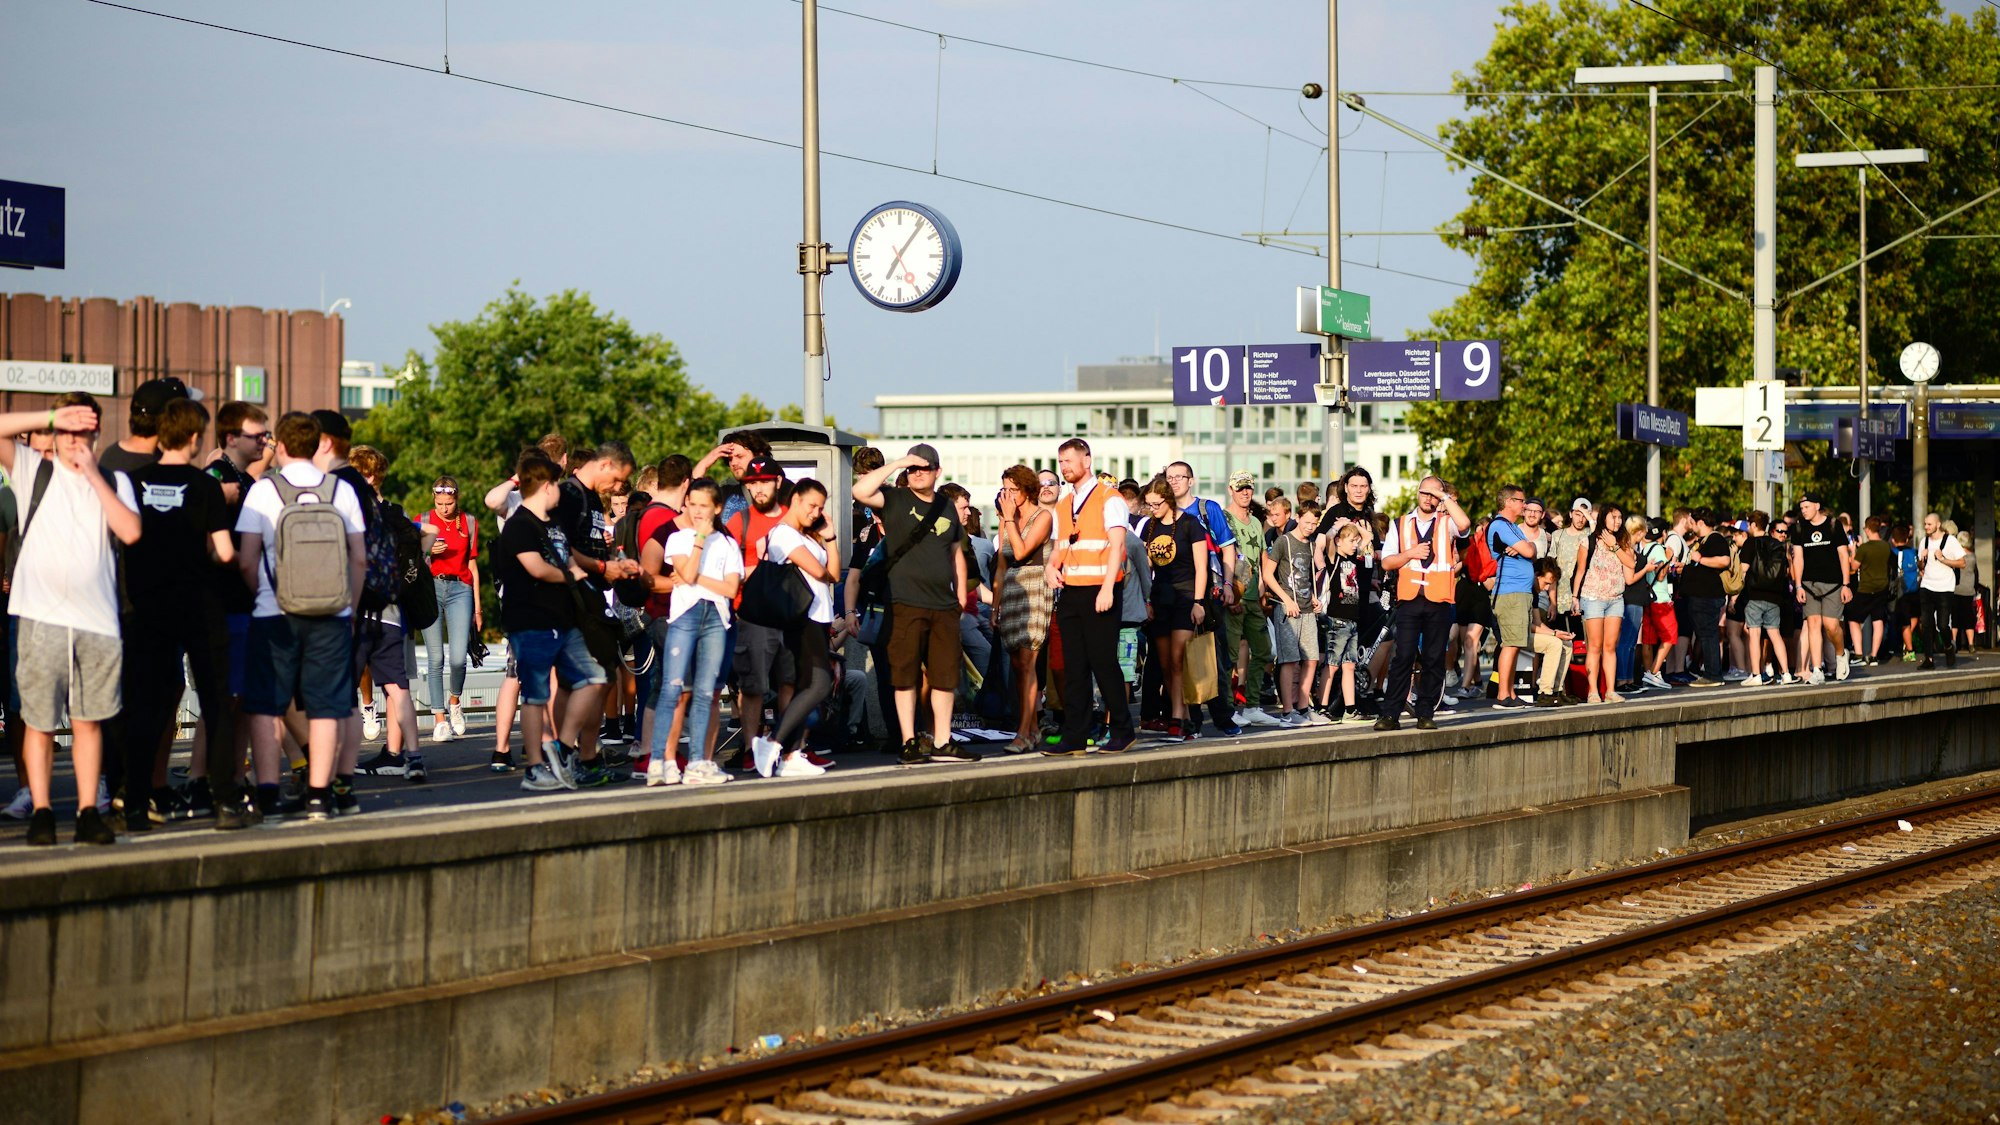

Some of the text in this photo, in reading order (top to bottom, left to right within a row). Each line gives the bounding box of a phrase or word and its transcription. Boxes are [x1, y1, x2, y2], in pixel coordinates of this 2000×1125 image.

[1253, 352, 1278, 360] Richtung
[1404, 349, 1430, 357] Richtung
[1463, 341, 1491, 387] 9
[1180, 348, 1230, 392] 10
[1398, 369, 1431, 377] Düsseldorf
[1253, 371, 1279, 379] Köln-Hbf
[1253, 378, 1297, 387] Köln-Hansaring
[1377, 377, 1402, 385] Bergisch
[243, 375, 261, 397] 11
[1253, 385, 1289, 394] Köln-Nippes
[1253, 392, 1292, 401] Neuss, Düren
[1758, 384, 1769, 412] 1
[1638, 409, 1681, 436] Köln Messe/Deutz
[1756, 415, 1773, 443] 2
